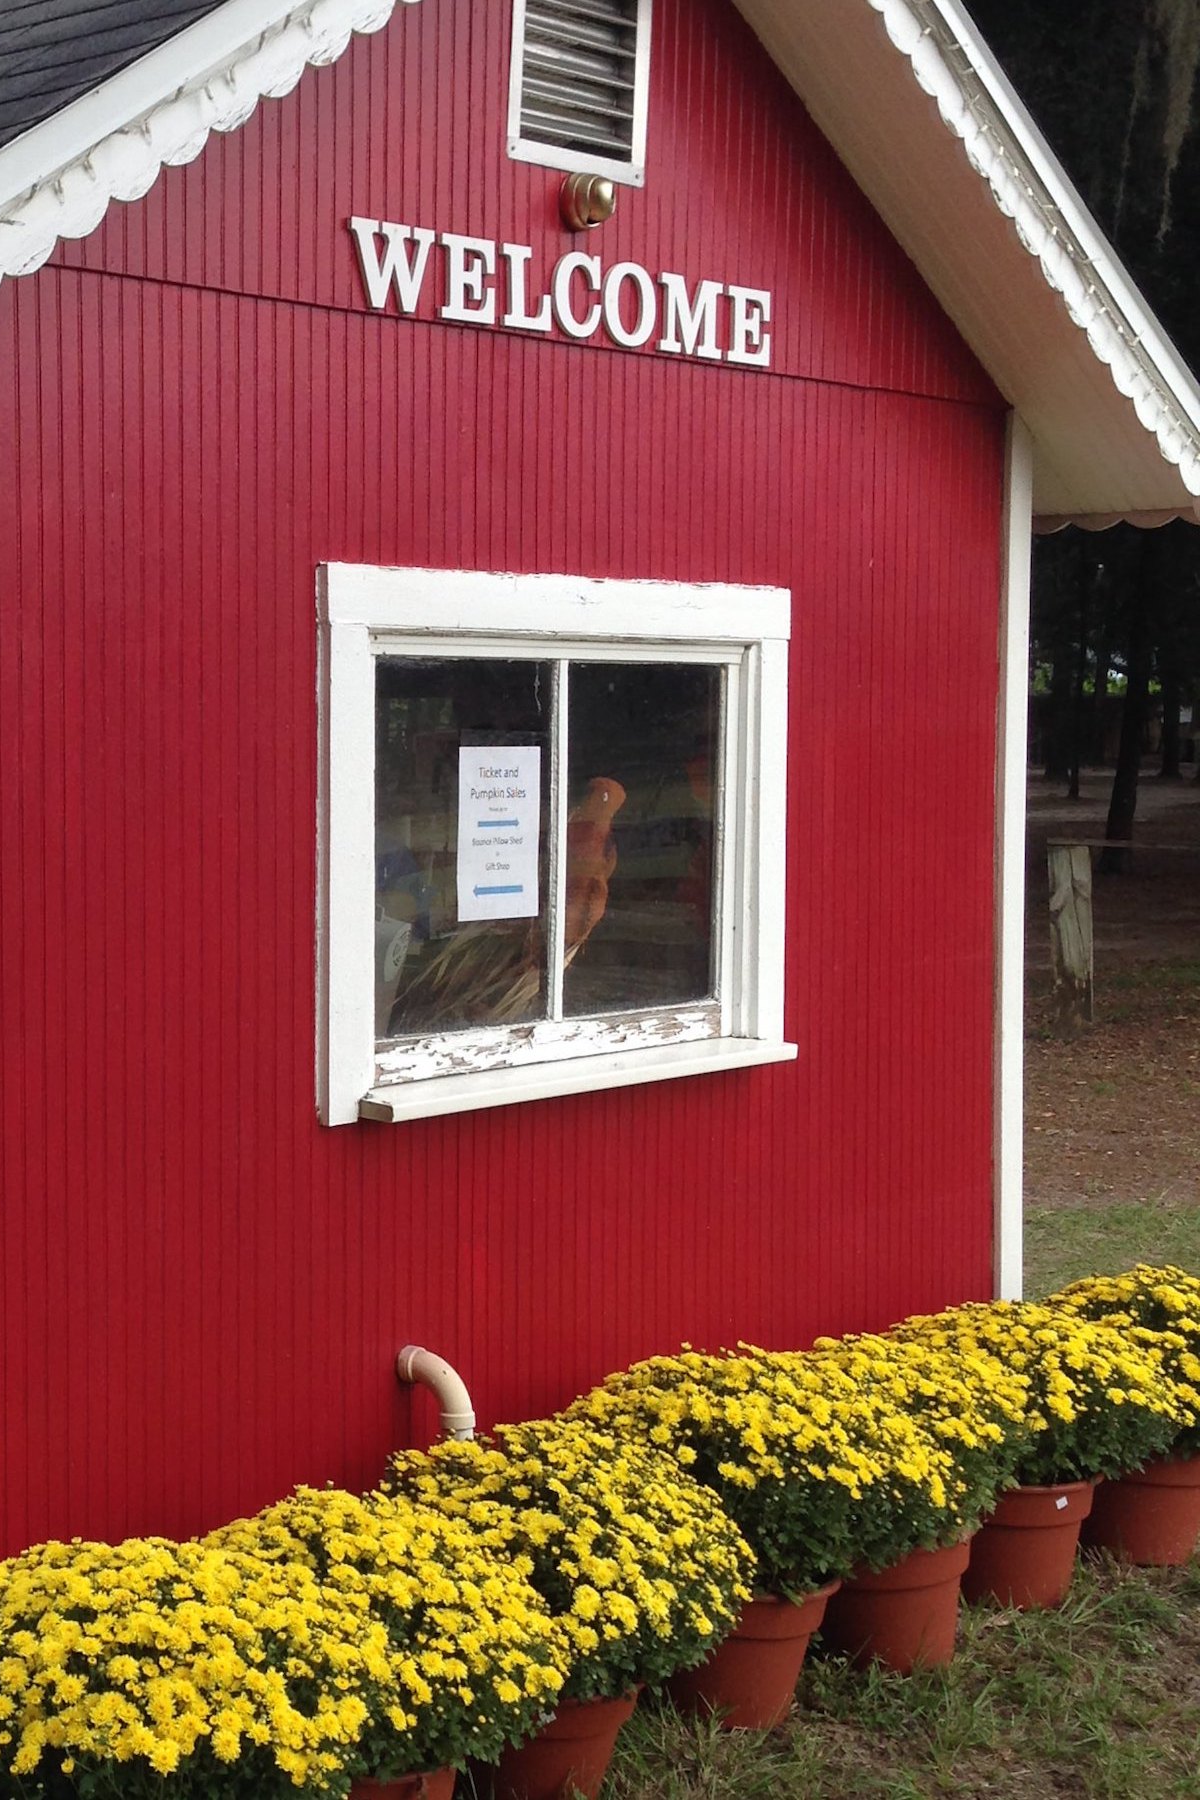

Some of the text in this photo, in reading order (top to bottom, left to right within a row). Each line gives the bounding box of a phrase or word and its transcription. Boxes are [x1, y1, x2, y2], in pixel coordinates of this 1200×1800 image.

[349, 215, 771, 367] WELCOME
[479, 767, 519, 778] Ticket and
[470, 787, 526, 801] Pumpkin Sales
